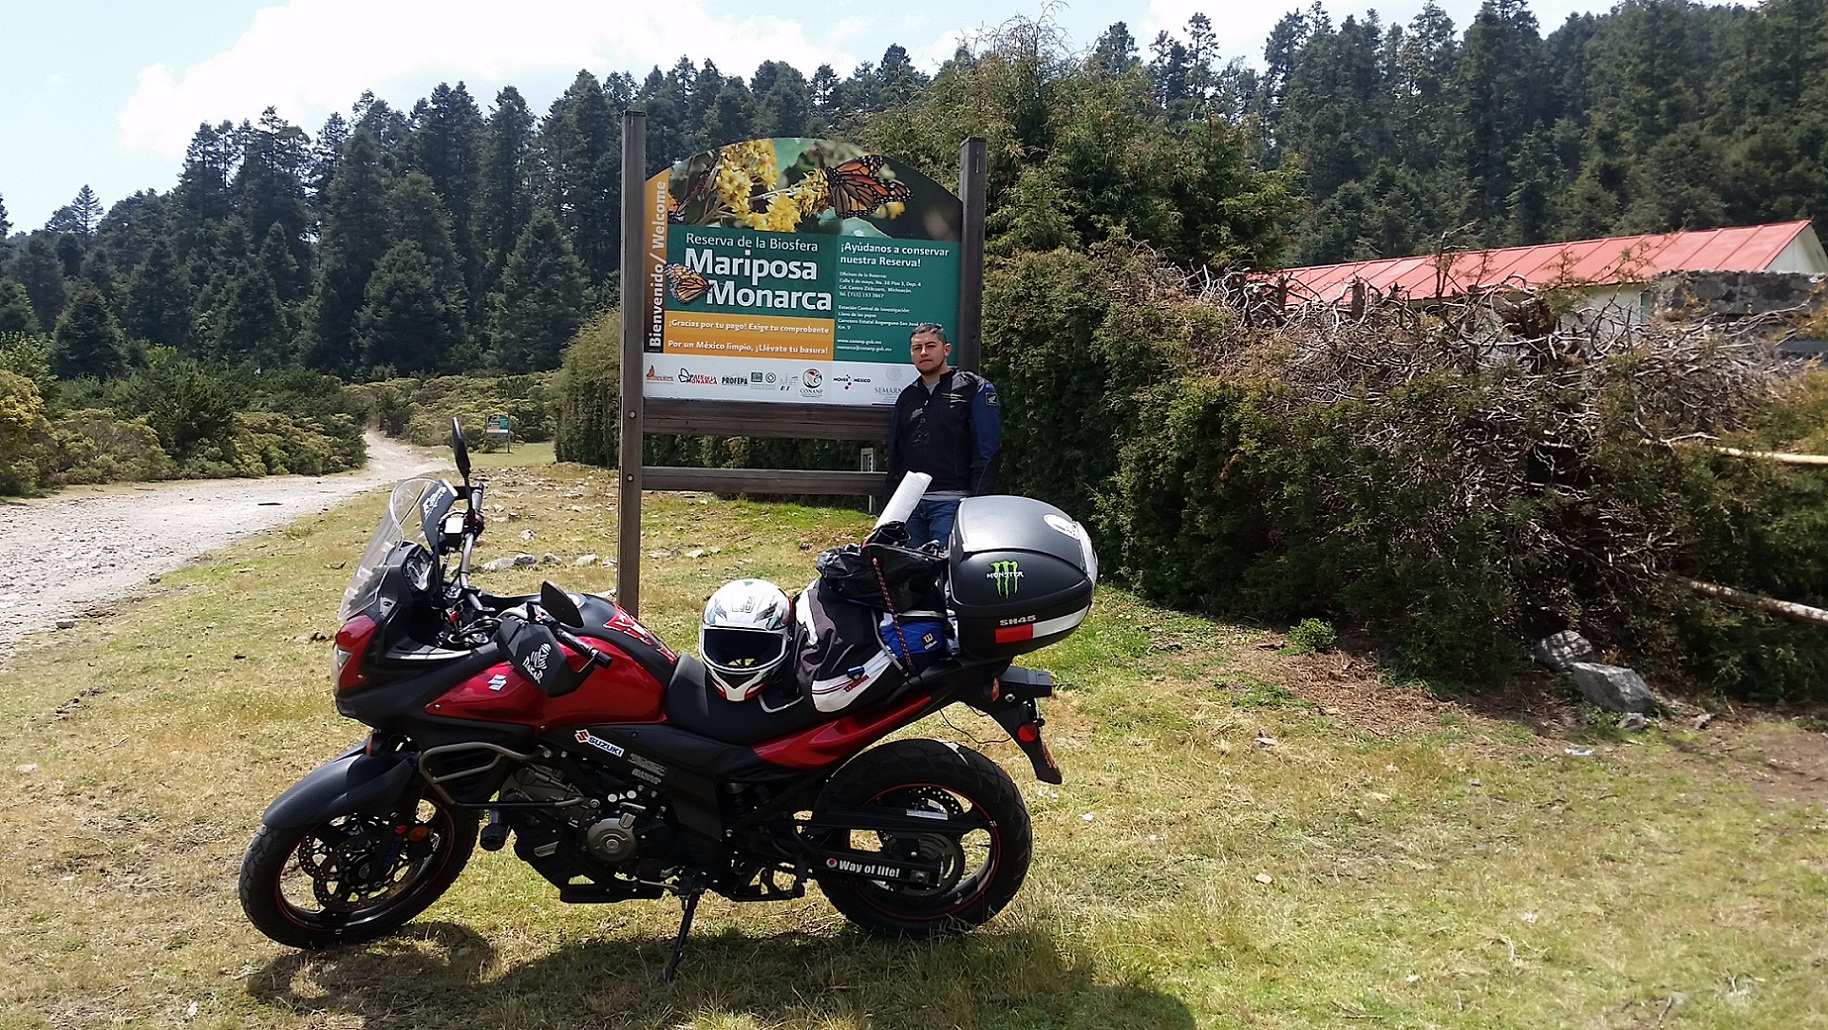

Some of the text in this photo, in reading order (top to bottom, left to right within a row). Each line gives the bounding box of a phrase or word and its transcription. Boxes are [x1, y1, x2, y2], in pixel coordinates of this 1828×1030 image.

[652, 181, 667, 250] Welcome
[686, 232, 818, 252] Reserva de la Biosfera
[840, 241, 950, 256] ¡Ayúdanos a conservar
[685, 248, 818, 286] Mariposa
[840, 256, 921, 267] nuestra Reserva!
[706, 279, 832, 311] Monarca
[669, 319, 699, 328] ¡Gracias
[700, 321, 715, 330] por
[715, 321, 724, 329] tu
[725, 323, 747, 332] pago!
[748, 323, 769, 333] Exige
[780, 325, 829, 334] comprobante
[668, 340, 682, 348] Por
[696, 340, 725, 350] México
[726, 341, 754, 352] limpio,
[799, 346, 829, 355] basura!
[721, 376, 749, 385] PROFEPA
[986, 570, 1025, 579] MONSTER
[1000, 614, 1037, 626] SH45
[588, 736, 623, 756] SUZUKI
[839, 860, 901, 878] Way of life!
